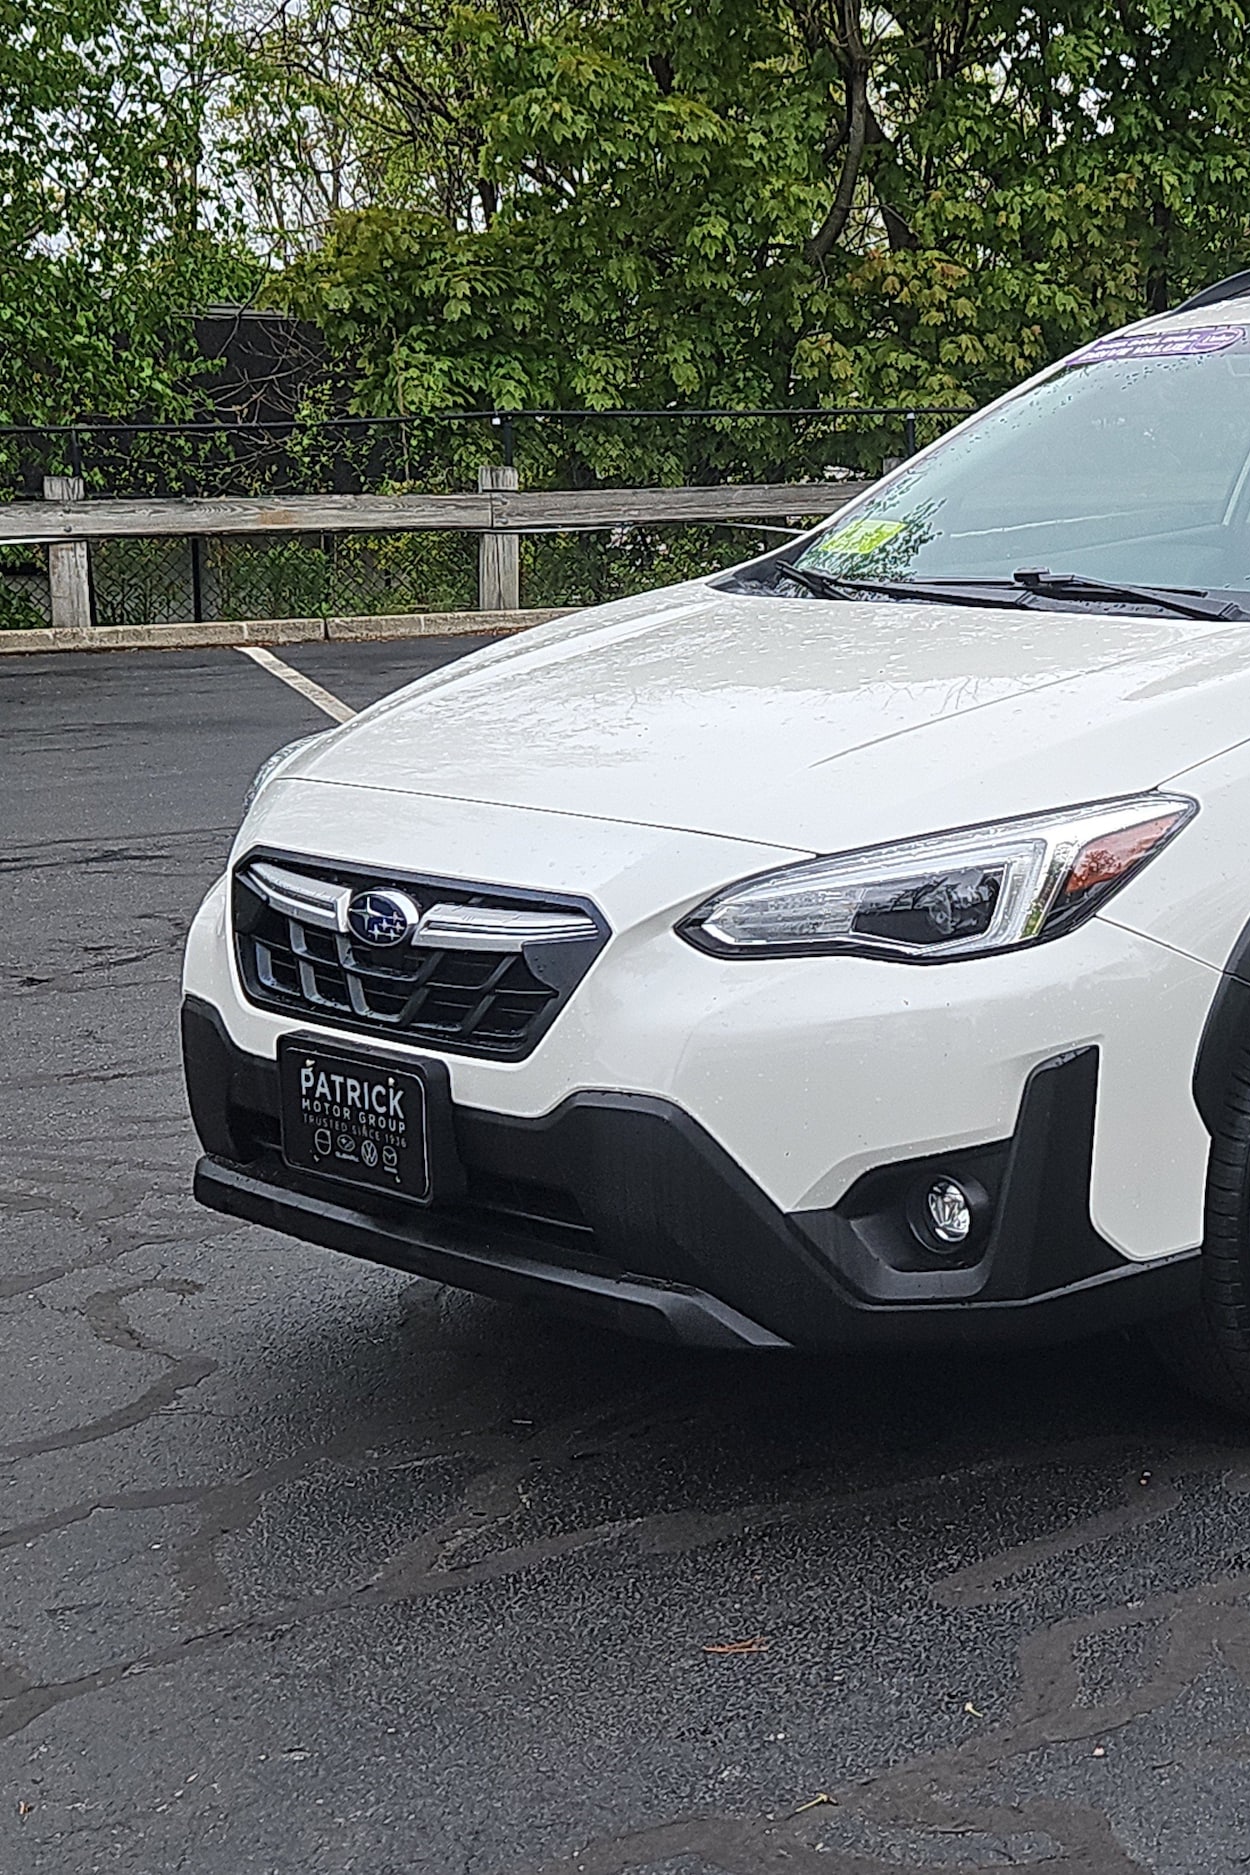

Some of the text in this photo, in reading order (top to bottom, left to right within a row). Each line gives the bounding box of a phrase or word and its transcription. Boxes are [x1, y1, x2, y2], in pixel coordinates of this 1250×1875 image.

[300, 1067, 405, 1119] PATRICK
[301, 1098, 406, 1133] MOTOR GROUP
[303, 1113, 348, 1132] TRUSTED
[351, 1123, 381, 1142] SINCE
